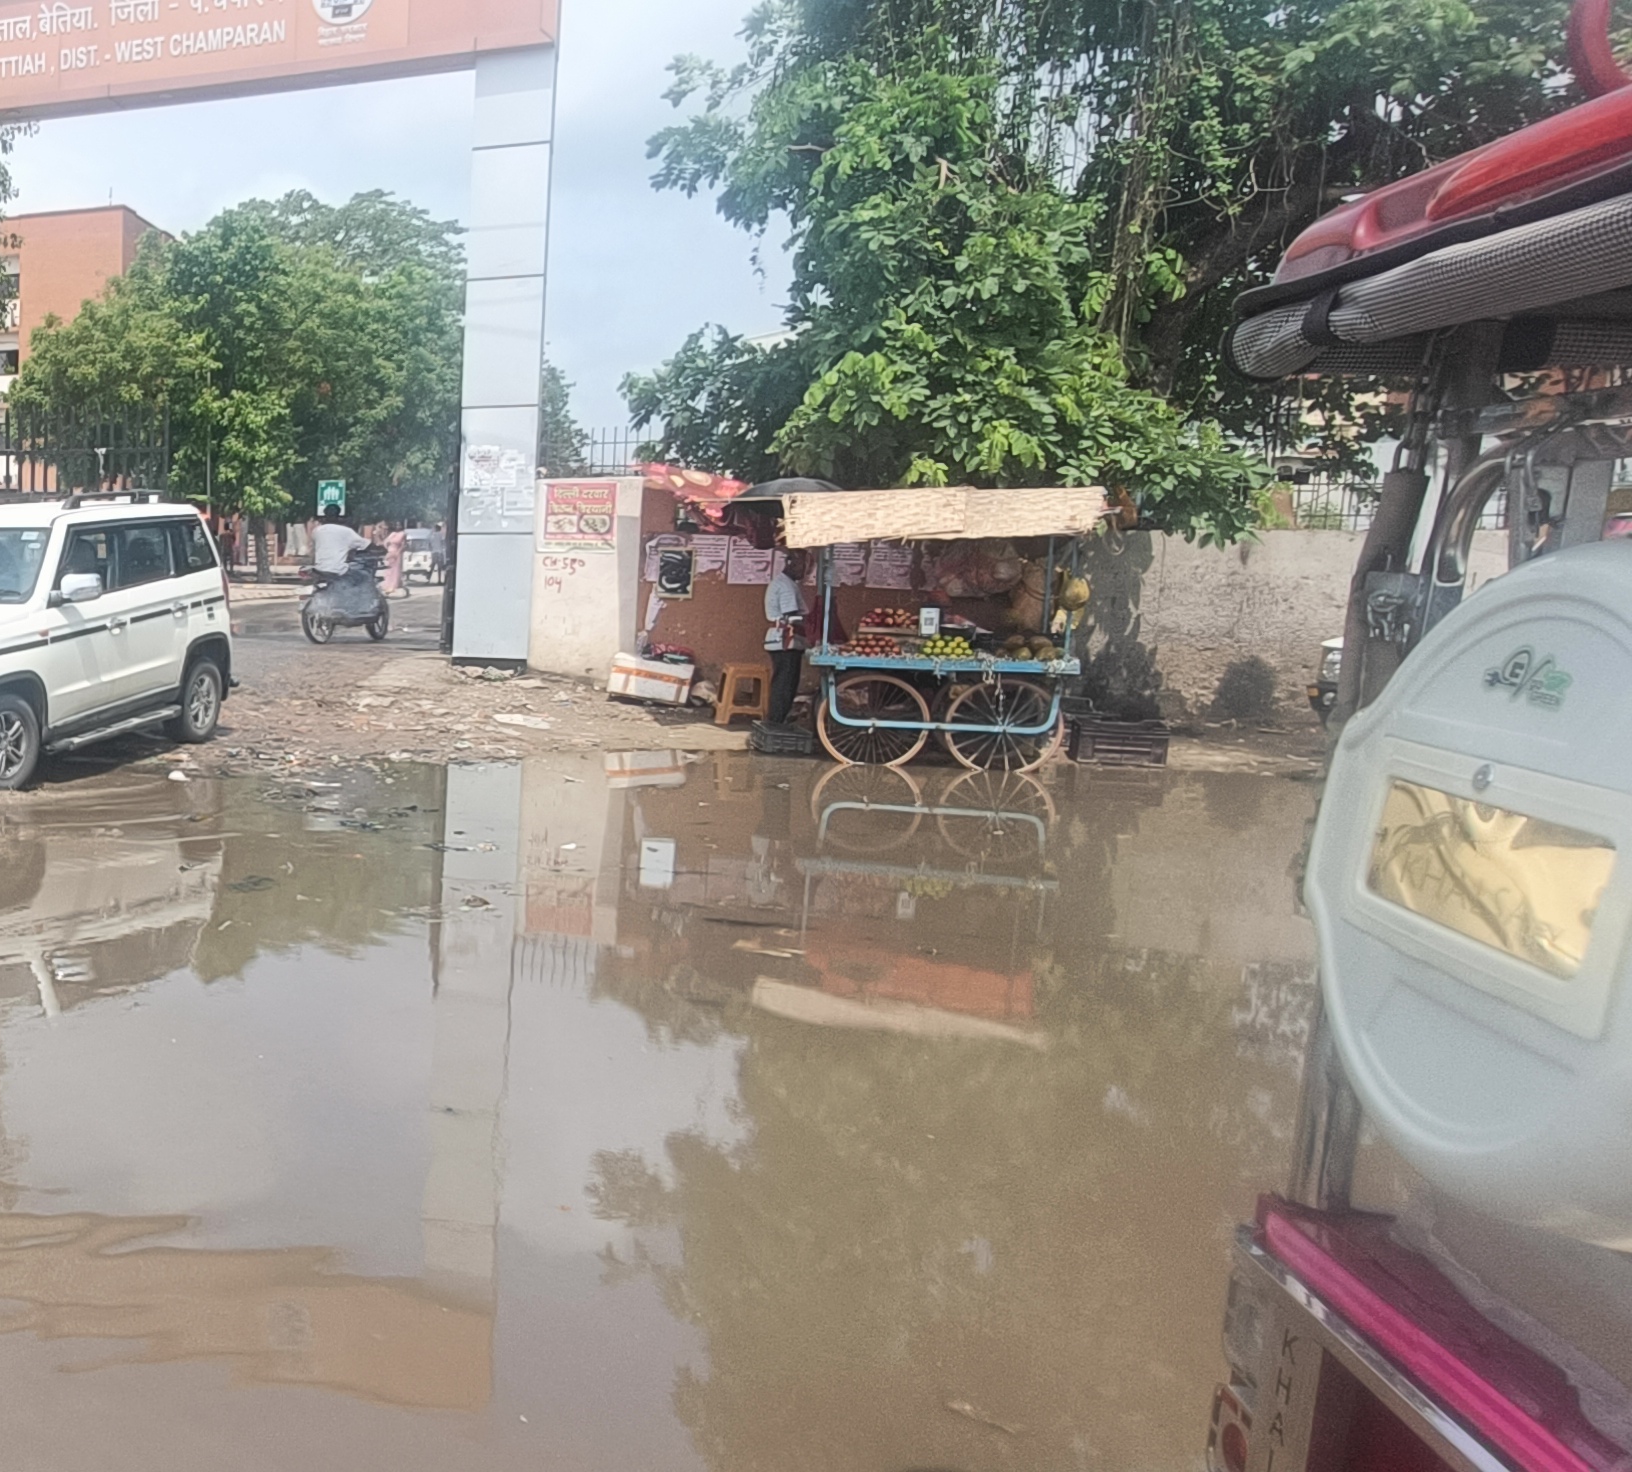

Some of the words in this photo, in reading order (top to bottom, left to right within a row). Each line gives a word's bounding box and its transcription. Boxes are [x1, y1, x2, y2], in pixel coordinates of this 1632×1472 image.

[60, 45, 100, 72] DIST.
[114, 37, 164, 64] WEST
[169, 20, 286, 57] CHAMPARAN
